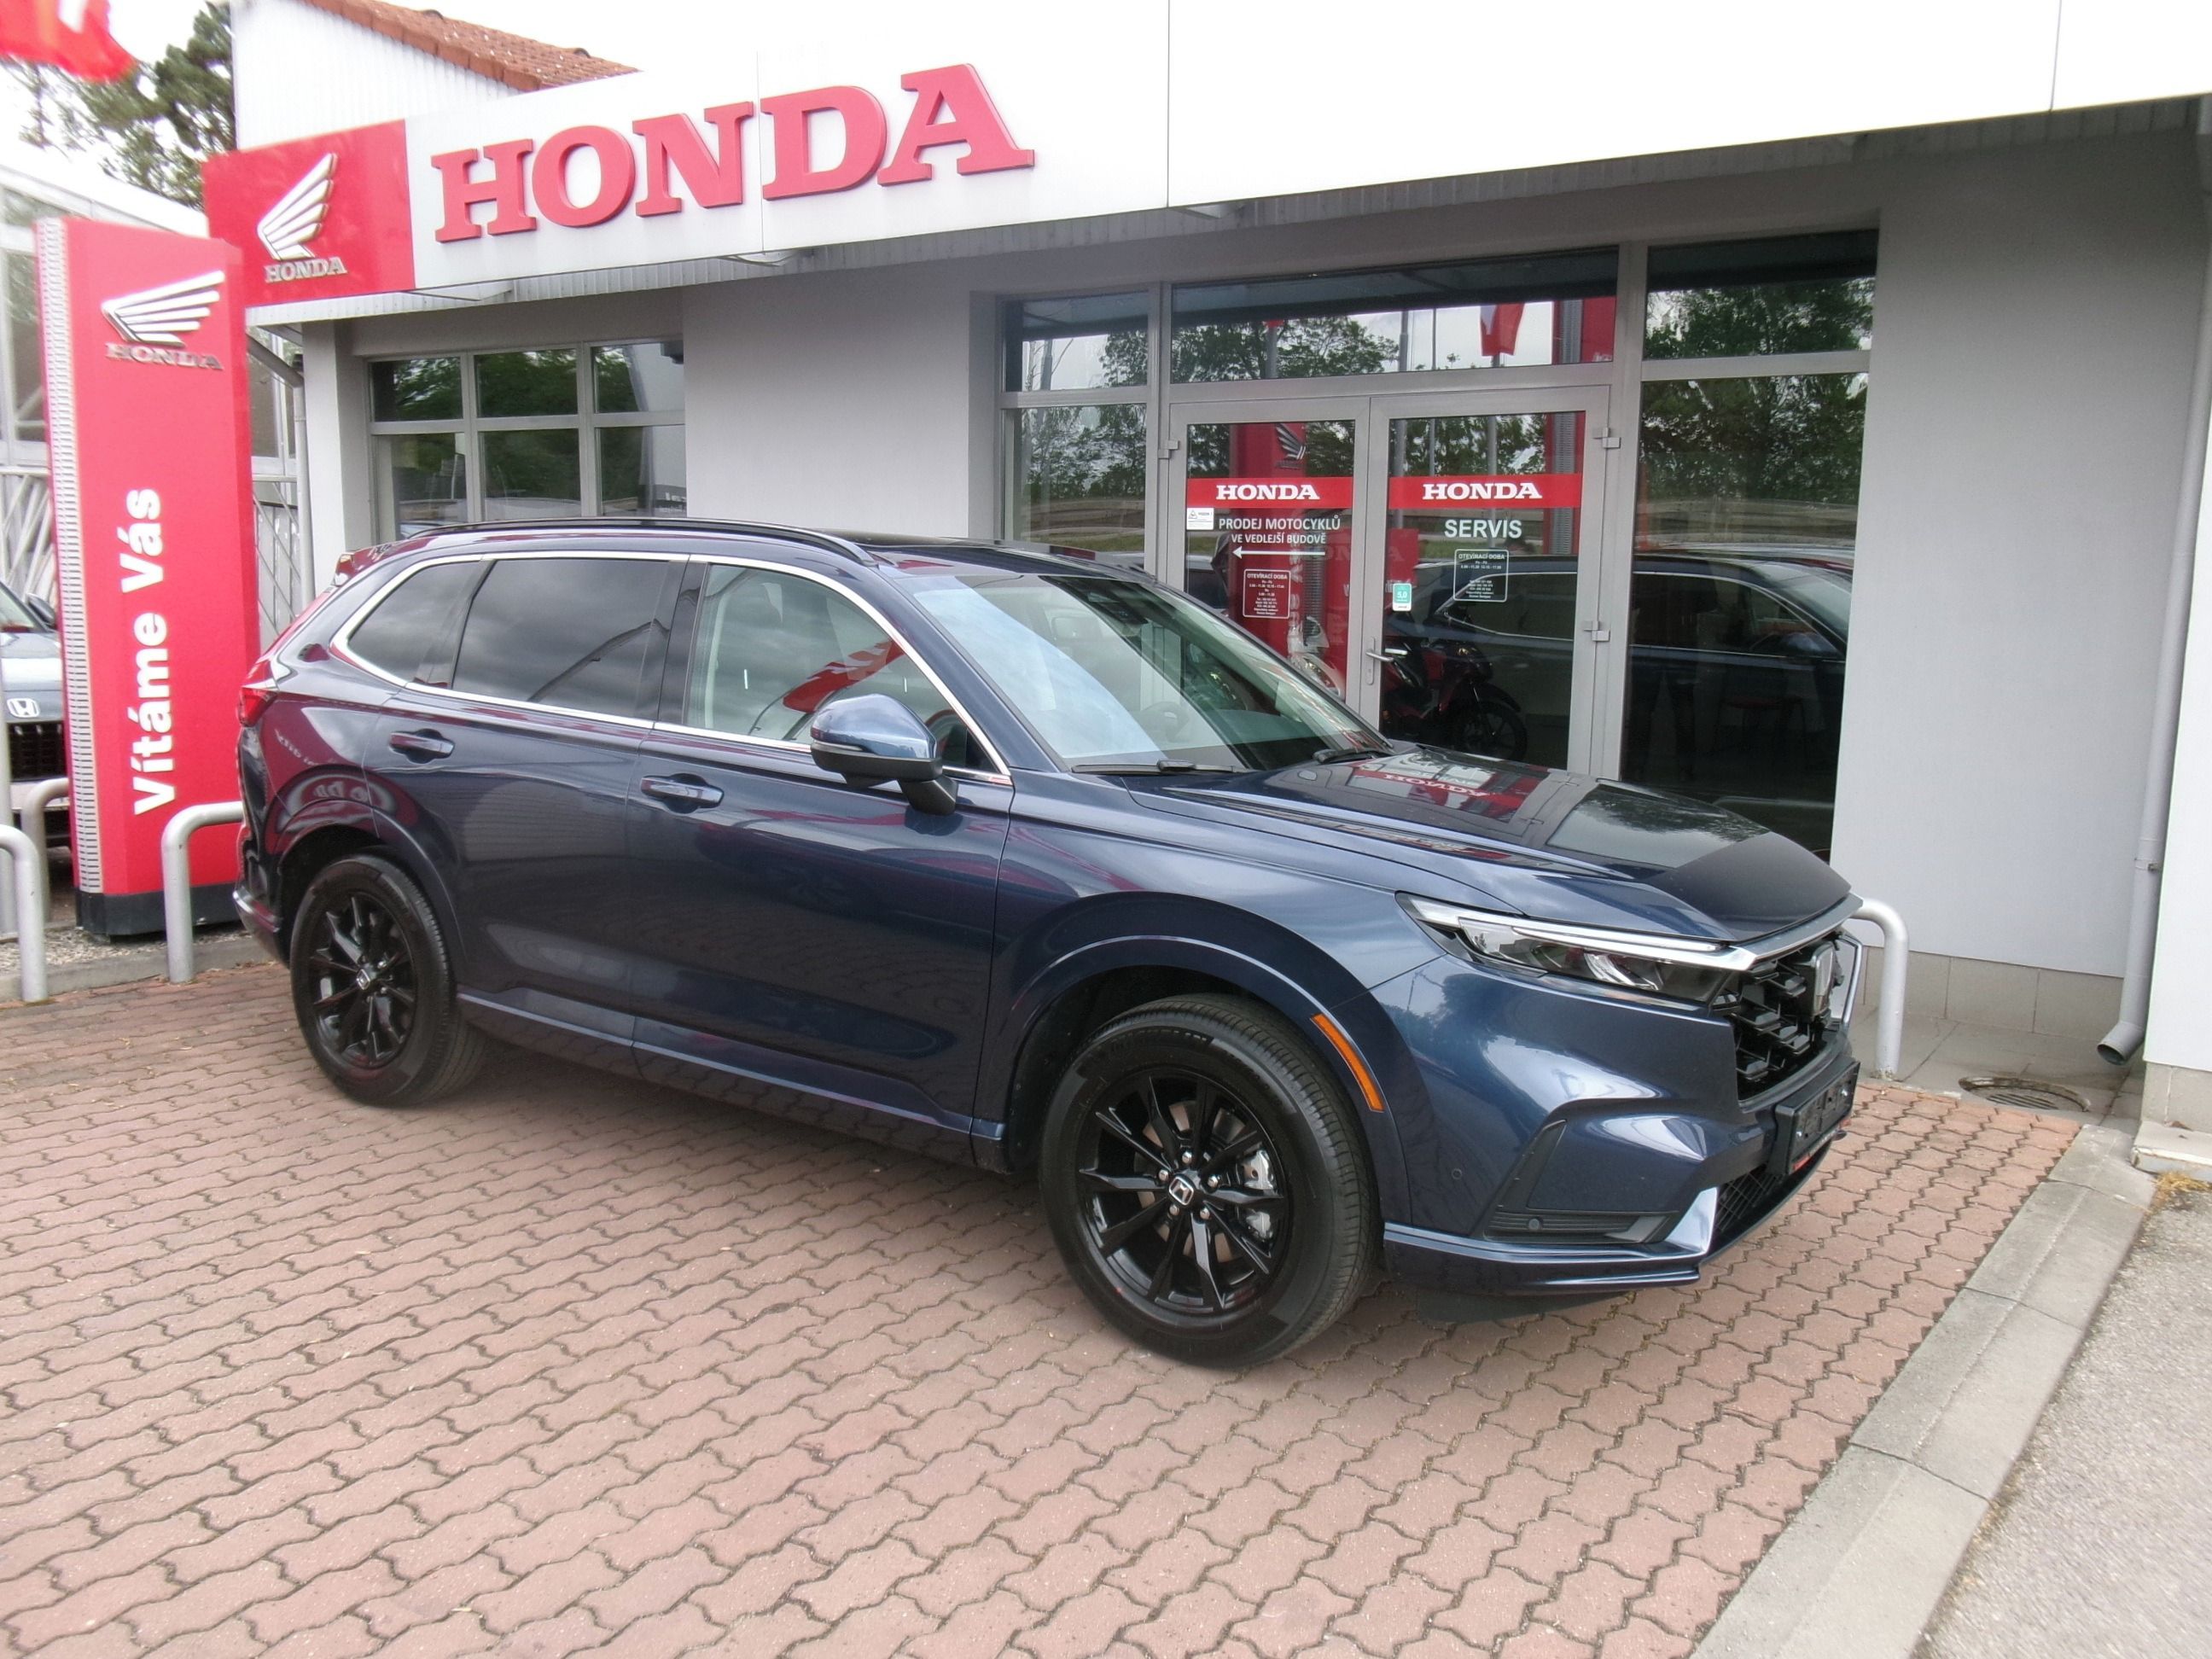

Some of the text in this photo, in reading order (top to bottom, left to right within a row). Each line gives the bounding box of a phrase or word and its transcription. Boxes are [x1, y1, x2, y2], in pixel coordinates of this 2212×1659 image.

[431, 62, 1035, 243] HONDA
[265, 256, 347, 283] HONDA
[105, 342, 224, 371] HONDA
[1215, 484, 1320, 500] HONDA
[1422, 482, 1543, 500] HONDA
[1219, 518, 1262, 530] PRODEJ
[1265, 515, 1341, 531] MOTOCYKLŮ
[1444, 519, 1522, 538] SERVIS
[1231, 532, 1326, 544] VE VEDLEJŠÍ BUDOVĚ
[117, 487, 176, 815] Vítáme Vás
